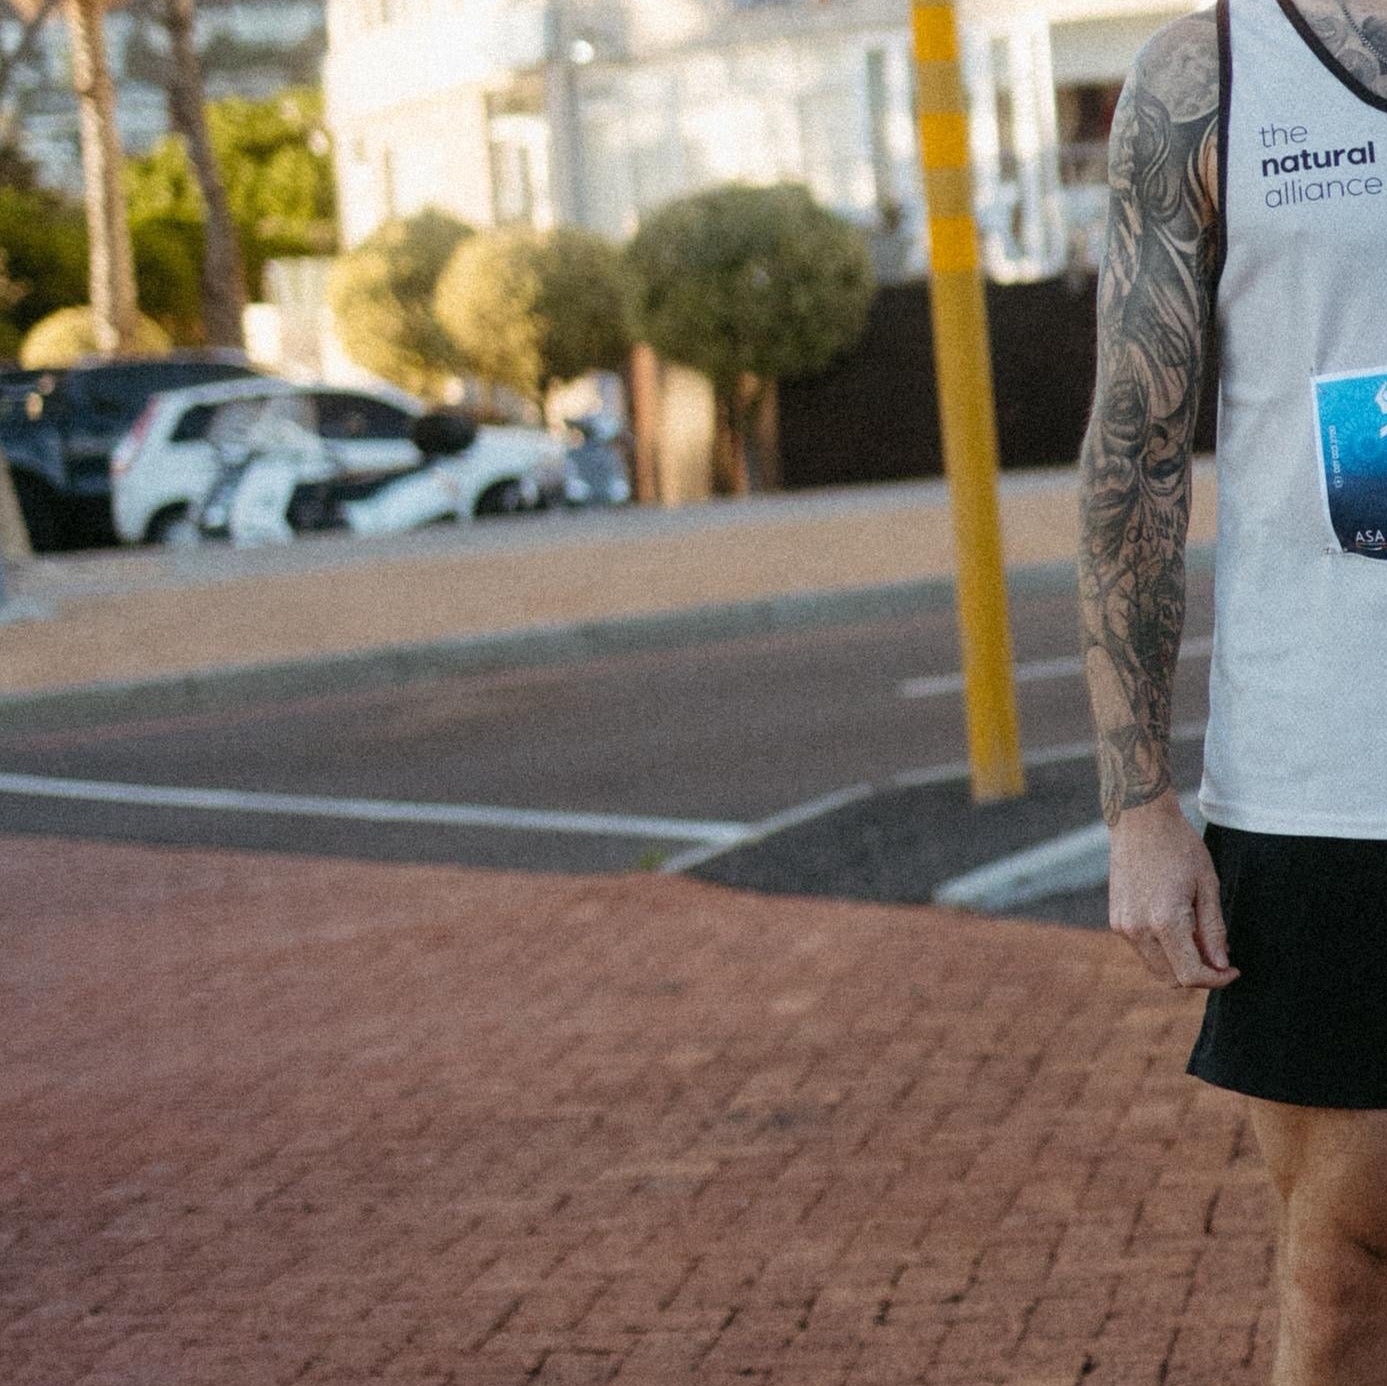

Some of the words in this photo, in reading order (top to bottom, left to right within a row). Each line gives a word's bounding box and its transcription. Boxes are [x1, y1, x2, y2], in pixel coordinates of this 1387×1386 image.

[1258, 124, 1308, 148] the
[1261, 141, 1376, 177] natural
[1355, 529, 1385, 543] ASA
